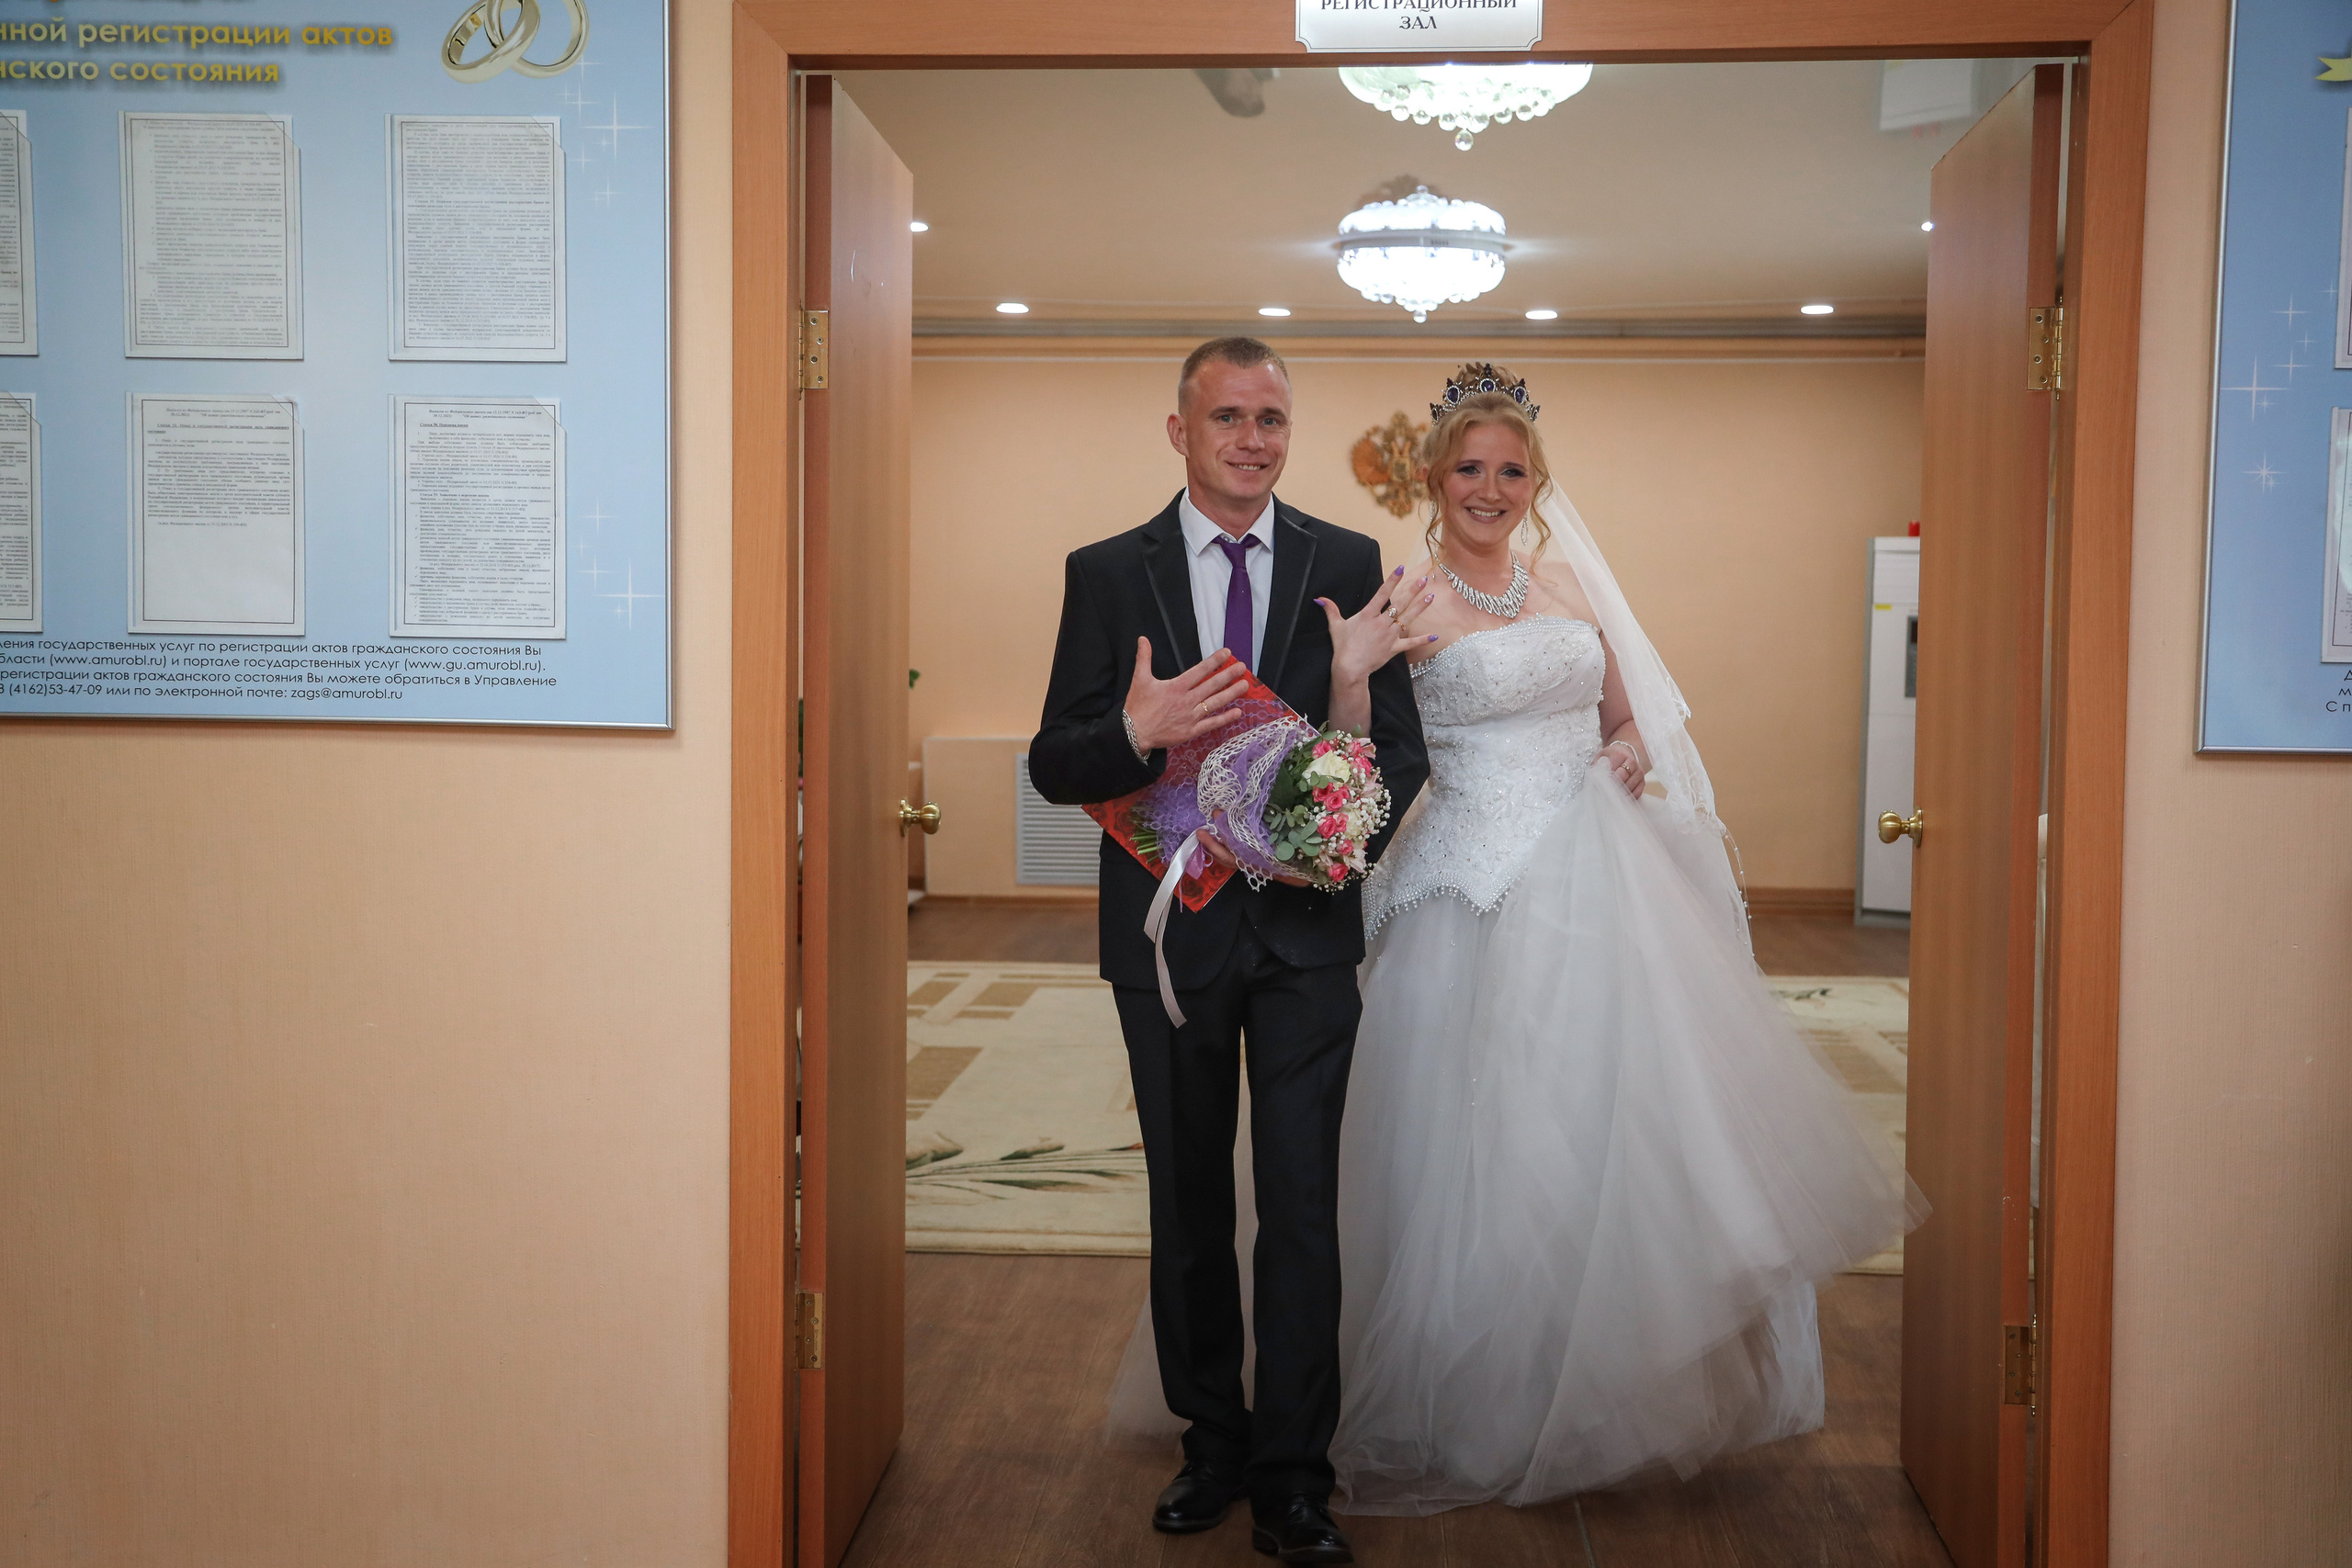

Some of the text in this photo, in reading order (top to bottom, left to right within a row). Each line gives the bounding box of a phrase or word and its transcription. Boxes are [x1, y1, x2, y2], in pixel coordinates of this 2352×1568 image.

[1399, 16, 1438, 29] ЗАЛ
[79, 23, 290, 49] регистрации
[301, 25, 392, 46] актов
[109, 62, 279, 82] состояния
[39, 641, 155, 651] государственных
[160, 643, 195, 653] услуг
[199, 643, 215, 651] по
[220, 644, 307, 654] регистрации
[312, 645, 347, 653] актов
[352, 645, 448, 655] гражданского
[453, 647, 520, 655] состояния
[526, 645, 541, 655] Вы
[50, 654, 166, 668] (www.amurobl.ru)
[184, 659, 240, 669] портале
[244, 659, 360, 670] государственных
[364, 660, 400, 671] услуг
[404, 659, 545, 672] (www.gu.amurobl.ru).
[1, 671, 89, 682] регистрации
[134, 672, 231, 682] гражданского
[234, 674, 302, 682] состояния
[308, 672, 322, 682] Вы
[327, 675, 380, 683] можете
[385, 673, 459, 686] обратиться
[474, 675, 557, 687] Управление
[9, 683, 102, 696] (4162)53-47-09
[155, 687, 243, 698] электронной
[247, 689, 287, 697] почте:
[291, 688, 402, 700] zags@amurobl.ru
